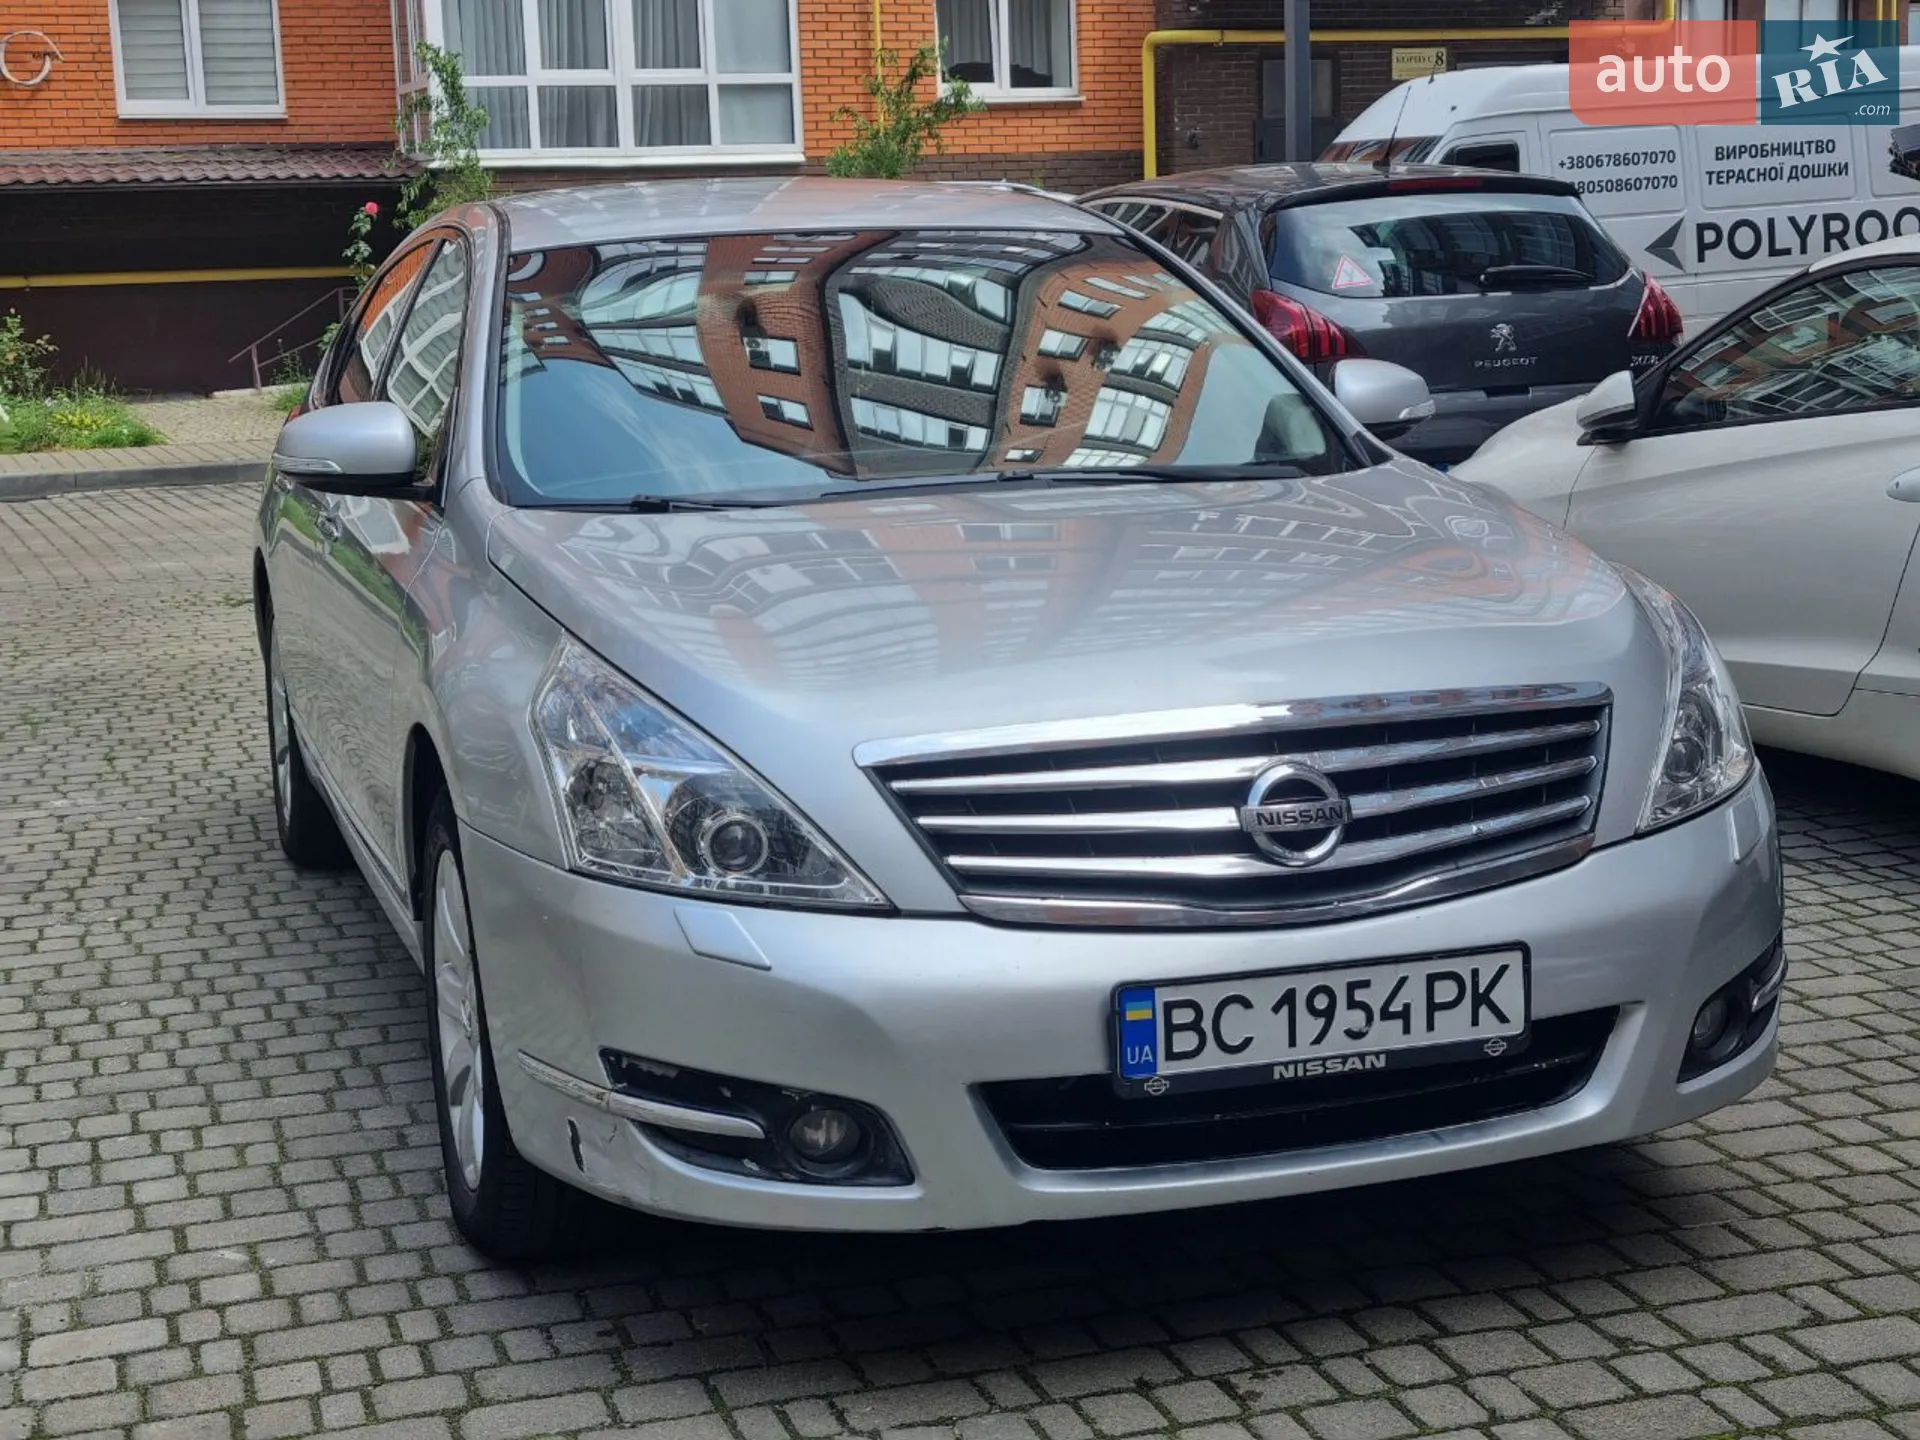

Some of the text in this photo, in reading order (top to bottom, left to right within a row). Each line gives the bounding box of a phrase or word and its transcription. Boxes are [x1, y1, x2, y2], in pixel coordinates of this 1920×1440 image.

[1435, 50, 1444, 66] 8
[1558, 150, 1676, 170] +380678607070
[1715, 139, 1836, 161] ВИРОБНИЦТВО
[1705, 162, 1850, 186] ТЕРАСНОЇ ДОШКИ
[1474, 356, 1539, 368] PEUGEOT
[1256, 805, 1344, 826] NISSAN
[1163, 963, 1511, 1062] BC 1954 PK
[1126, 1043, 1154, 1066] UA
[1272, 1052, 1387, 1080] NISSAN
